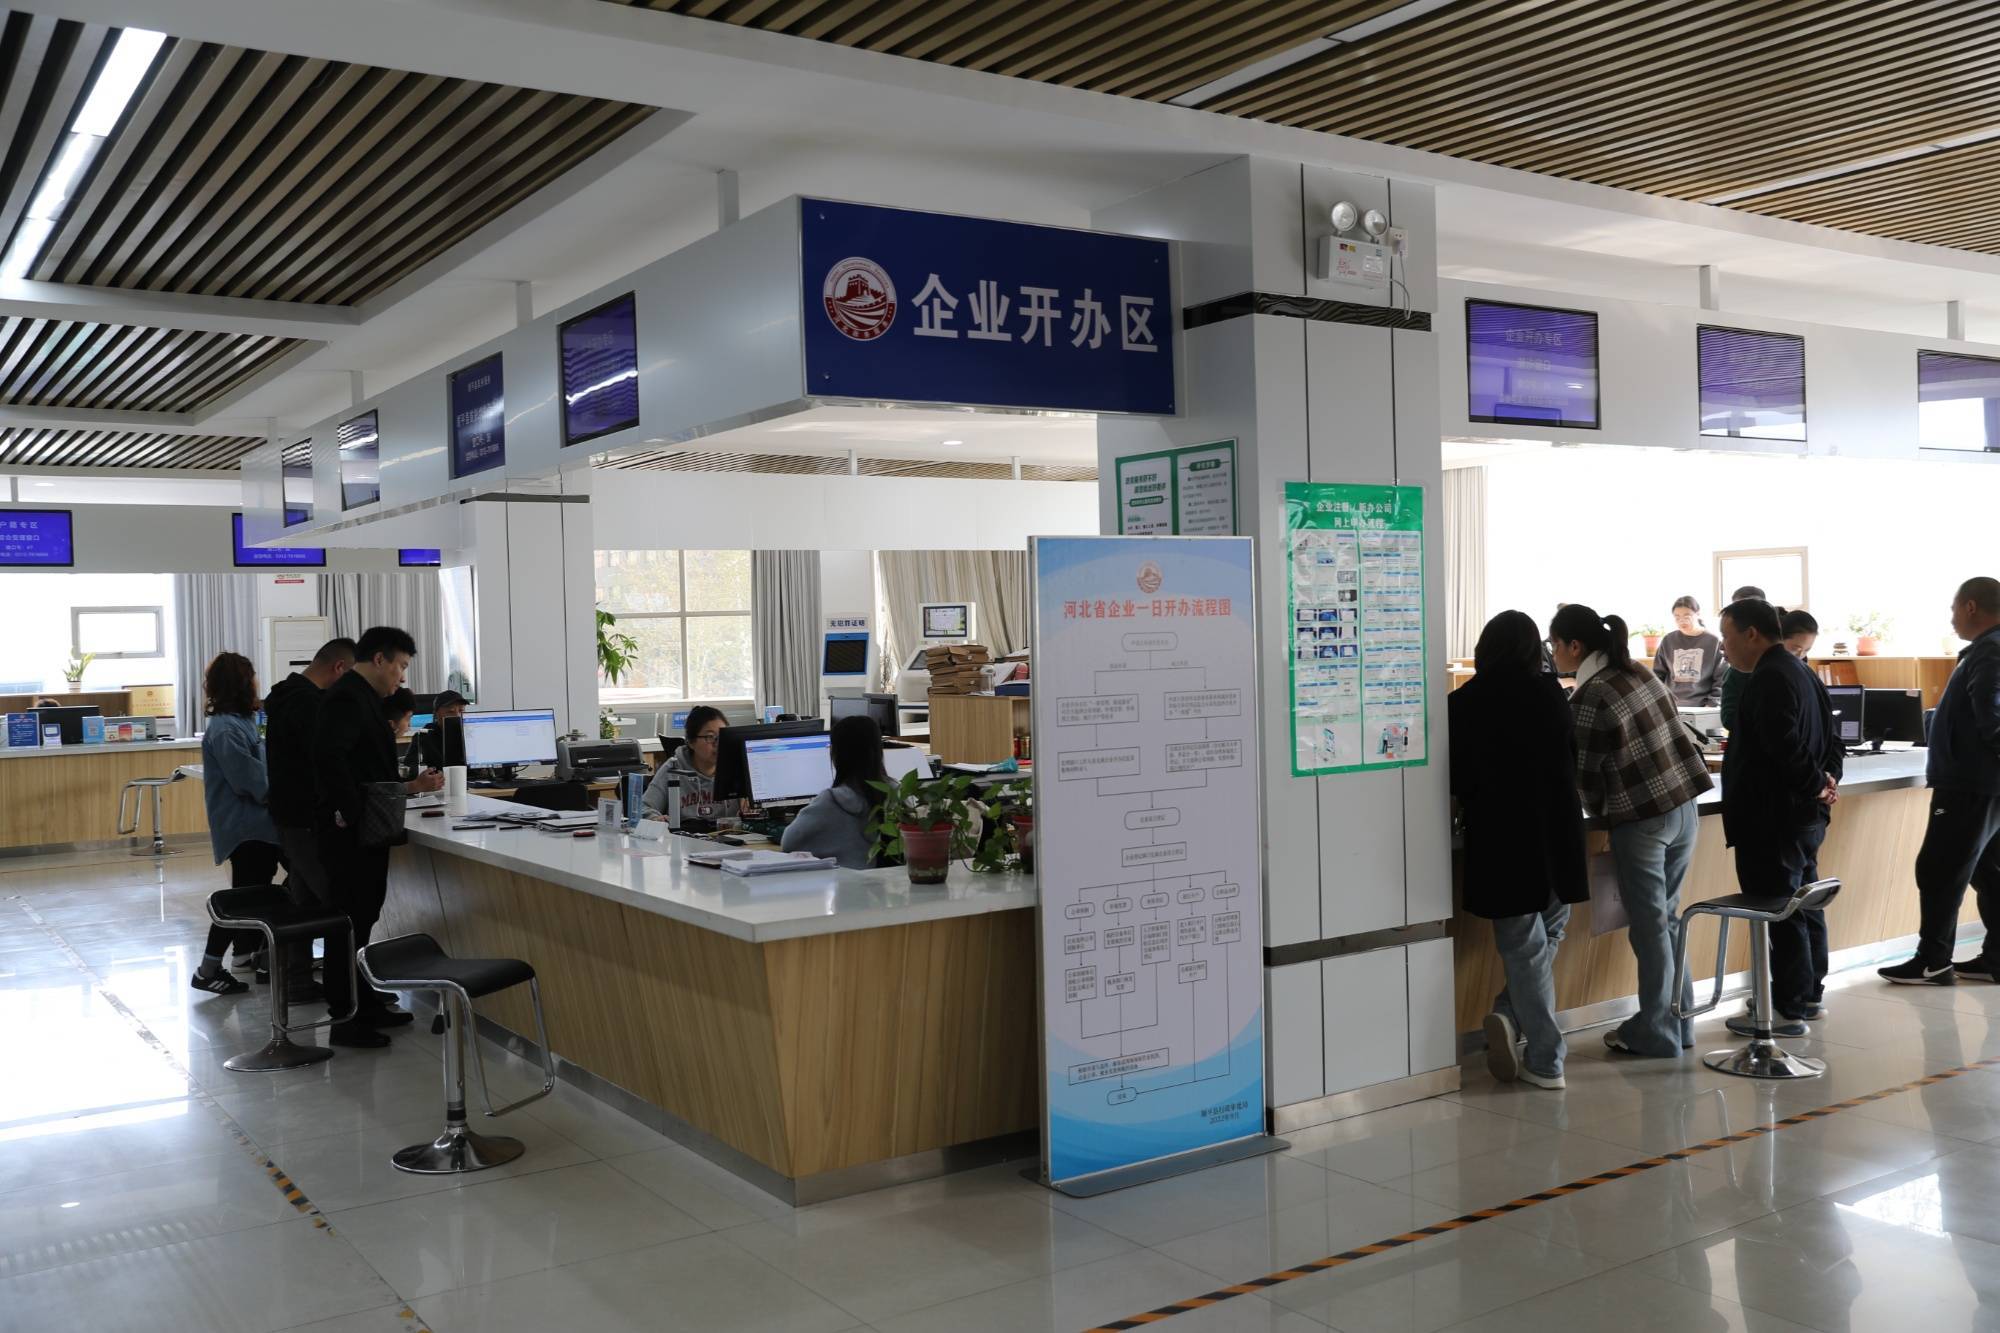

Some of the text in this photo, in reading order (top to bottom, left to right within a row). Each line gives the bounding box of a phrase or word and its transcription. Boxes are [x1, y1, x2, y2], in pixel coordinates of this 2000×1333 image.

[911, 273, 1158, 353] 企业开办区
[1064, 598, 1232, 618] 河北省企业一日开办流程图
